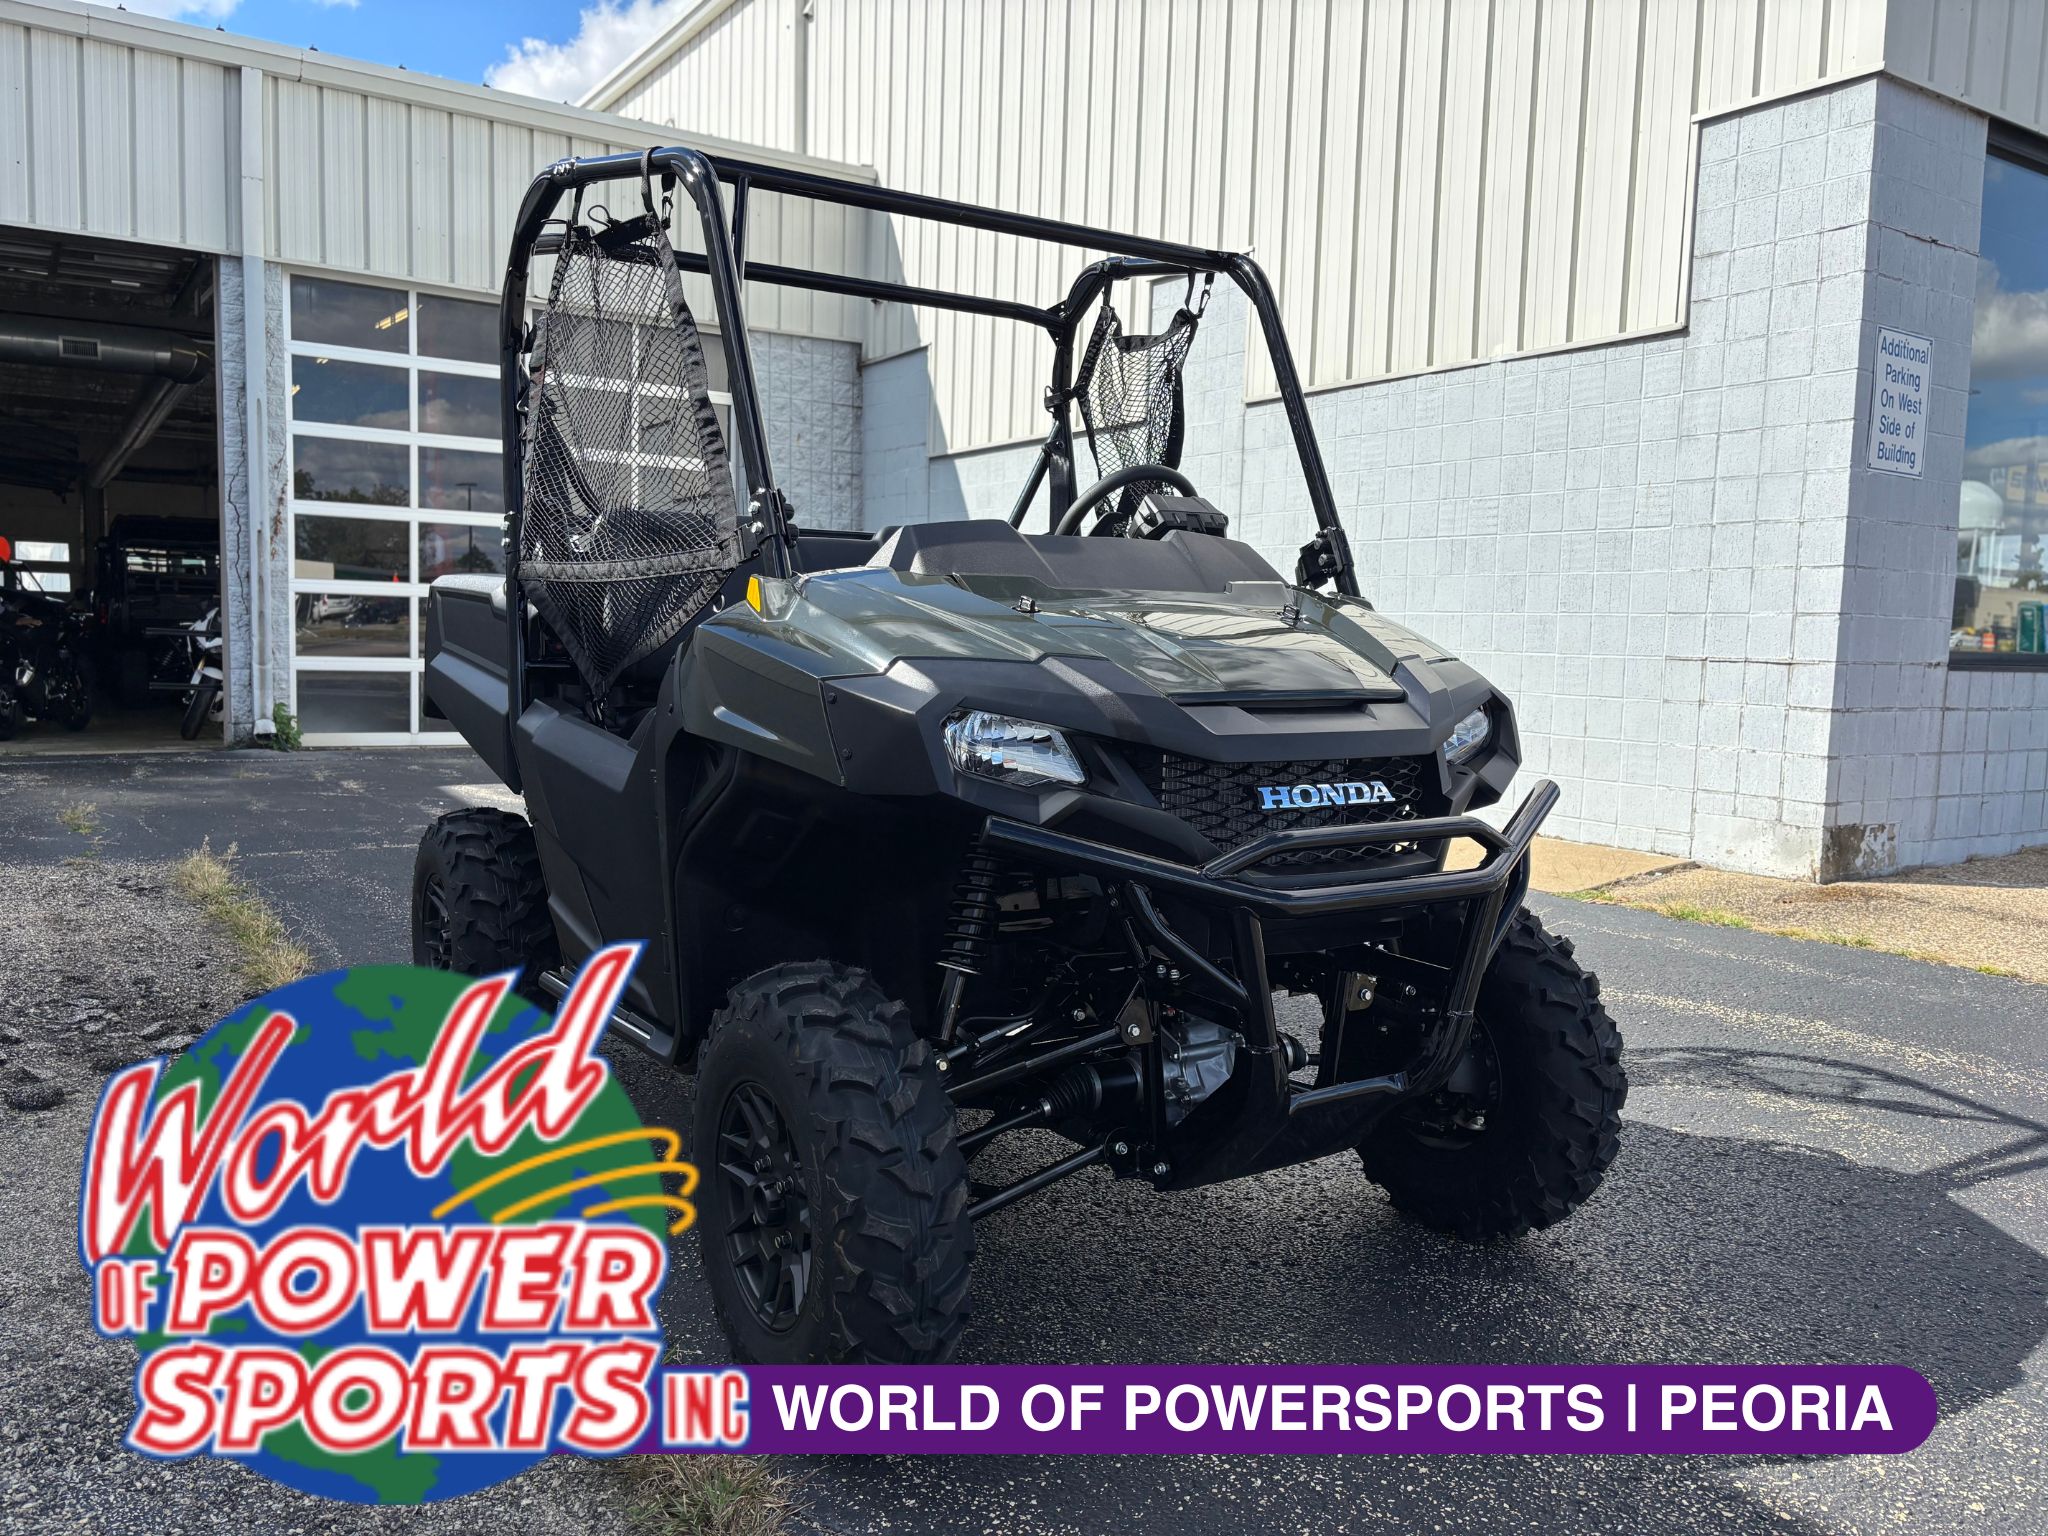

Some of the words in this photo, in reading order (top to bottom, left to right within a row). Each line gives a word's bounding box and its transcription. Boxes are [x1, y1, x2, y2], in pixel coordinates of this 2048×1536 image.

[1880, 335, 1929, 365] Additional
[1885, 363, 1921, 392] Parking
[1880, 389, 1894, 409] On
[1899, 392, 1922, 415] West
[1879, 415, 1901, 436] Side
[1905, 421, 1915, 439] of
[1877, 441, 1916, 469] Building
[1257, 780, 1396, 810] HONDA
